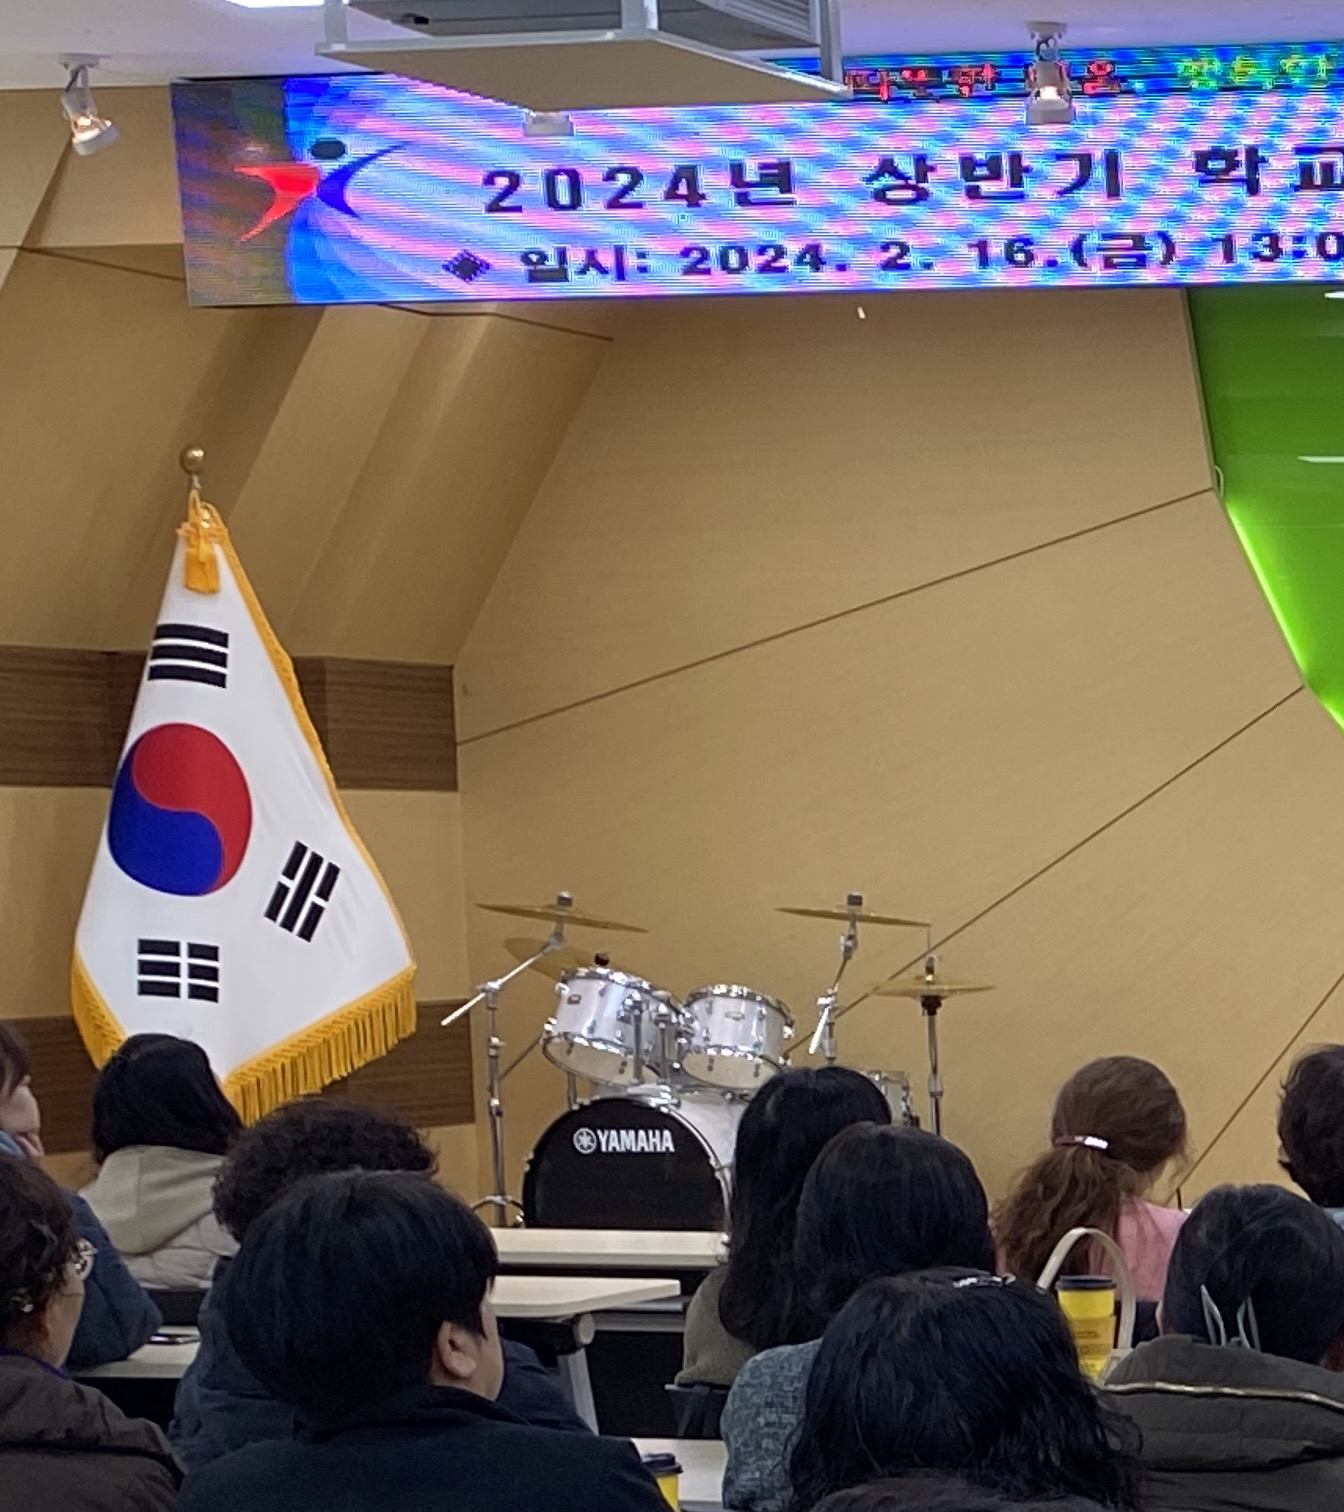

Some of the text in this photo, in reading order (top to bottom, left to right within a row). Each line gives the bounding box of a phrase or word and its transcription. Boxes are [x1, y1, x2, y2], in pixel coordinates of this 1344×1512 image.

[482, 157, 799, 214] 2024년
[865, 147, 1121, 207] 상반기
[521, 246, 650, 285] 일시:
[681, 242, 849, 276] 2024.
[880, 240, 935, 274] 2.
[597, 1128, 674, 1153] YAMAHA
